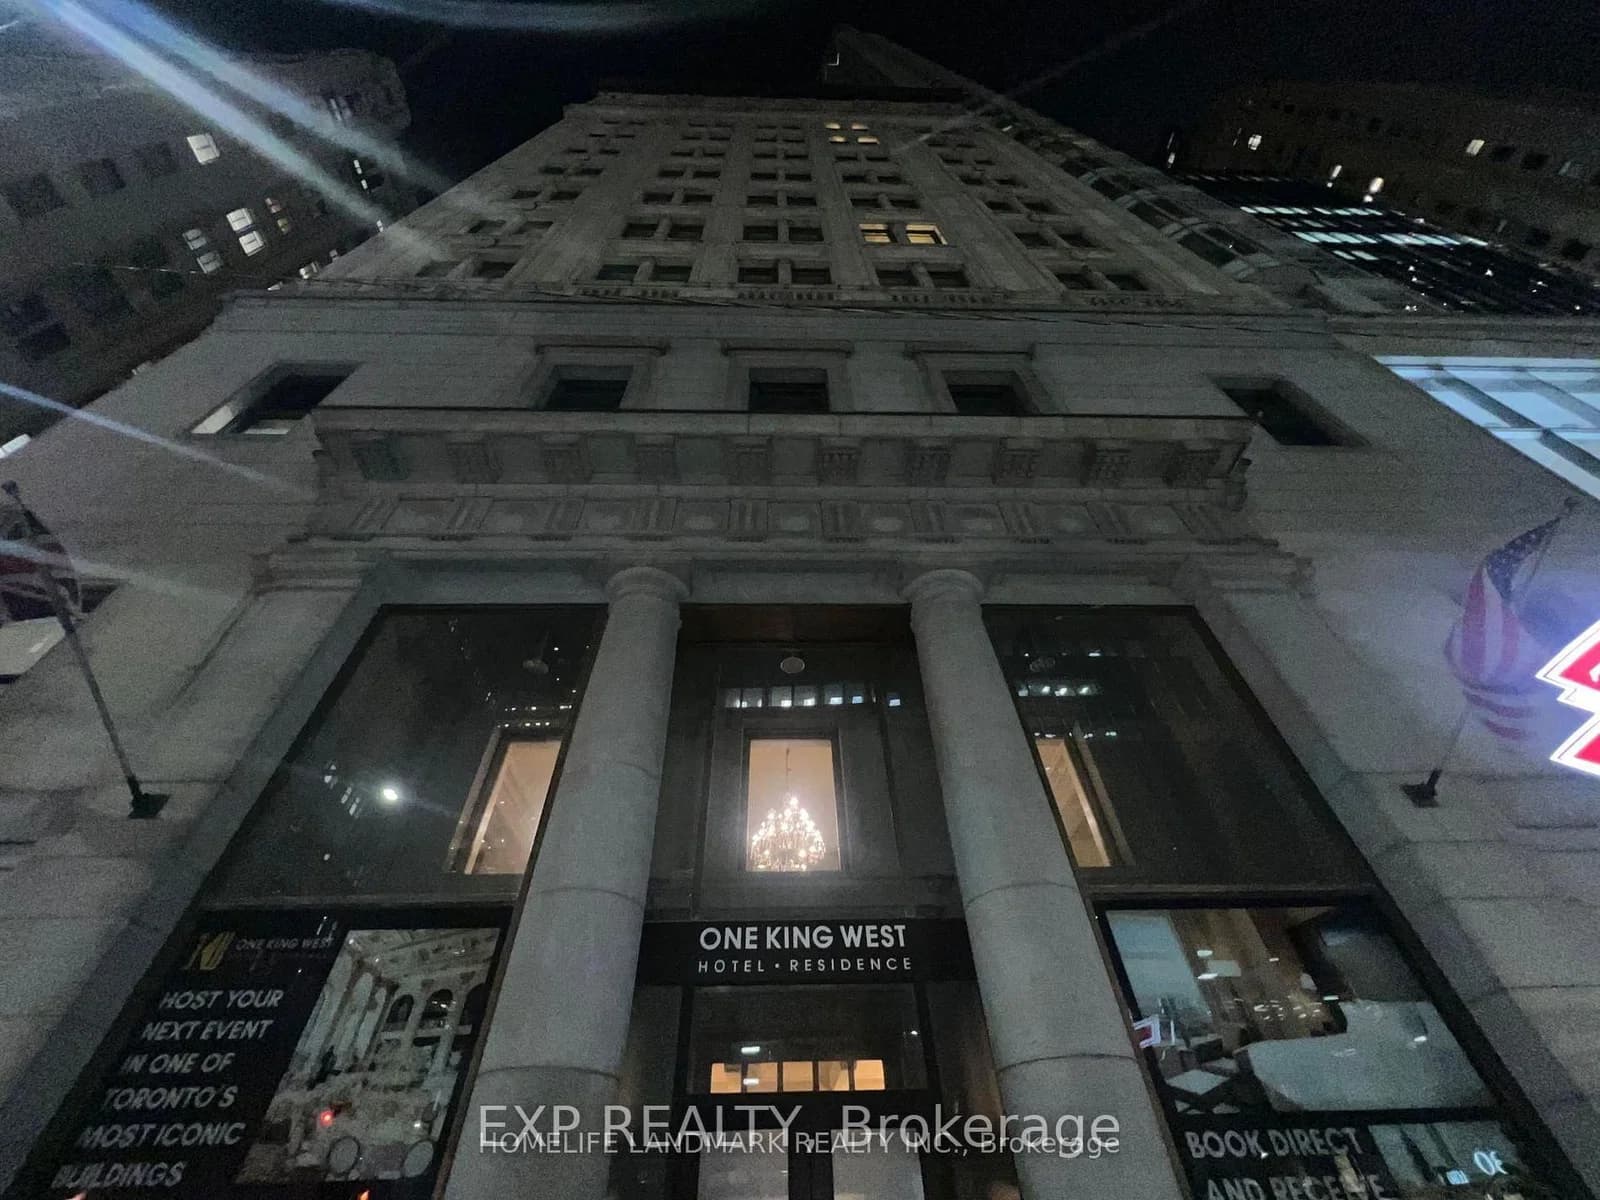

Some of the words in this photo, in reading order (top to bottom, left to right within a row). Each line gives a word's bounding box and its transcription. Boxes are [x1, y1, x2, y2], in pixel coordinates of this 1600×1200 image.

[266, 938, 299, 950] KING
[301, 937, 336, 949] WEST
[699, 926, 758, 950] ONE
[766, 925, 833, 949] KING
[839, 924, 906, 948] WEST
[698, 959, 765, 974] HOTEL
[789, 957, 913, 972] RESIDENCE
[159, 990, 223, 1010] HOST
[226, 989, 284, 1008] YOUR
[140, 1020, 202, 1041] NEXT
[201, 1019, 274, 1040] EVENT
[120, 1054, 148, 1074] IN
[150, 1053, 200, 1074] ONE
[201, 1052, 236, 1073] OF
[103, 1085, 239, 1110] TORONTO'S
[75, 1122, 156, 1148] MOST
[152, 1121, 247, 1146] ICONIC
[1184, 1128, 1265, 1159] BOOK
[1266, 1126, 1364, 1156] DIRECT
[51, 1160, 187, 1190] BUILDINGS
[1207, 1177, 1266, 1200] AND
